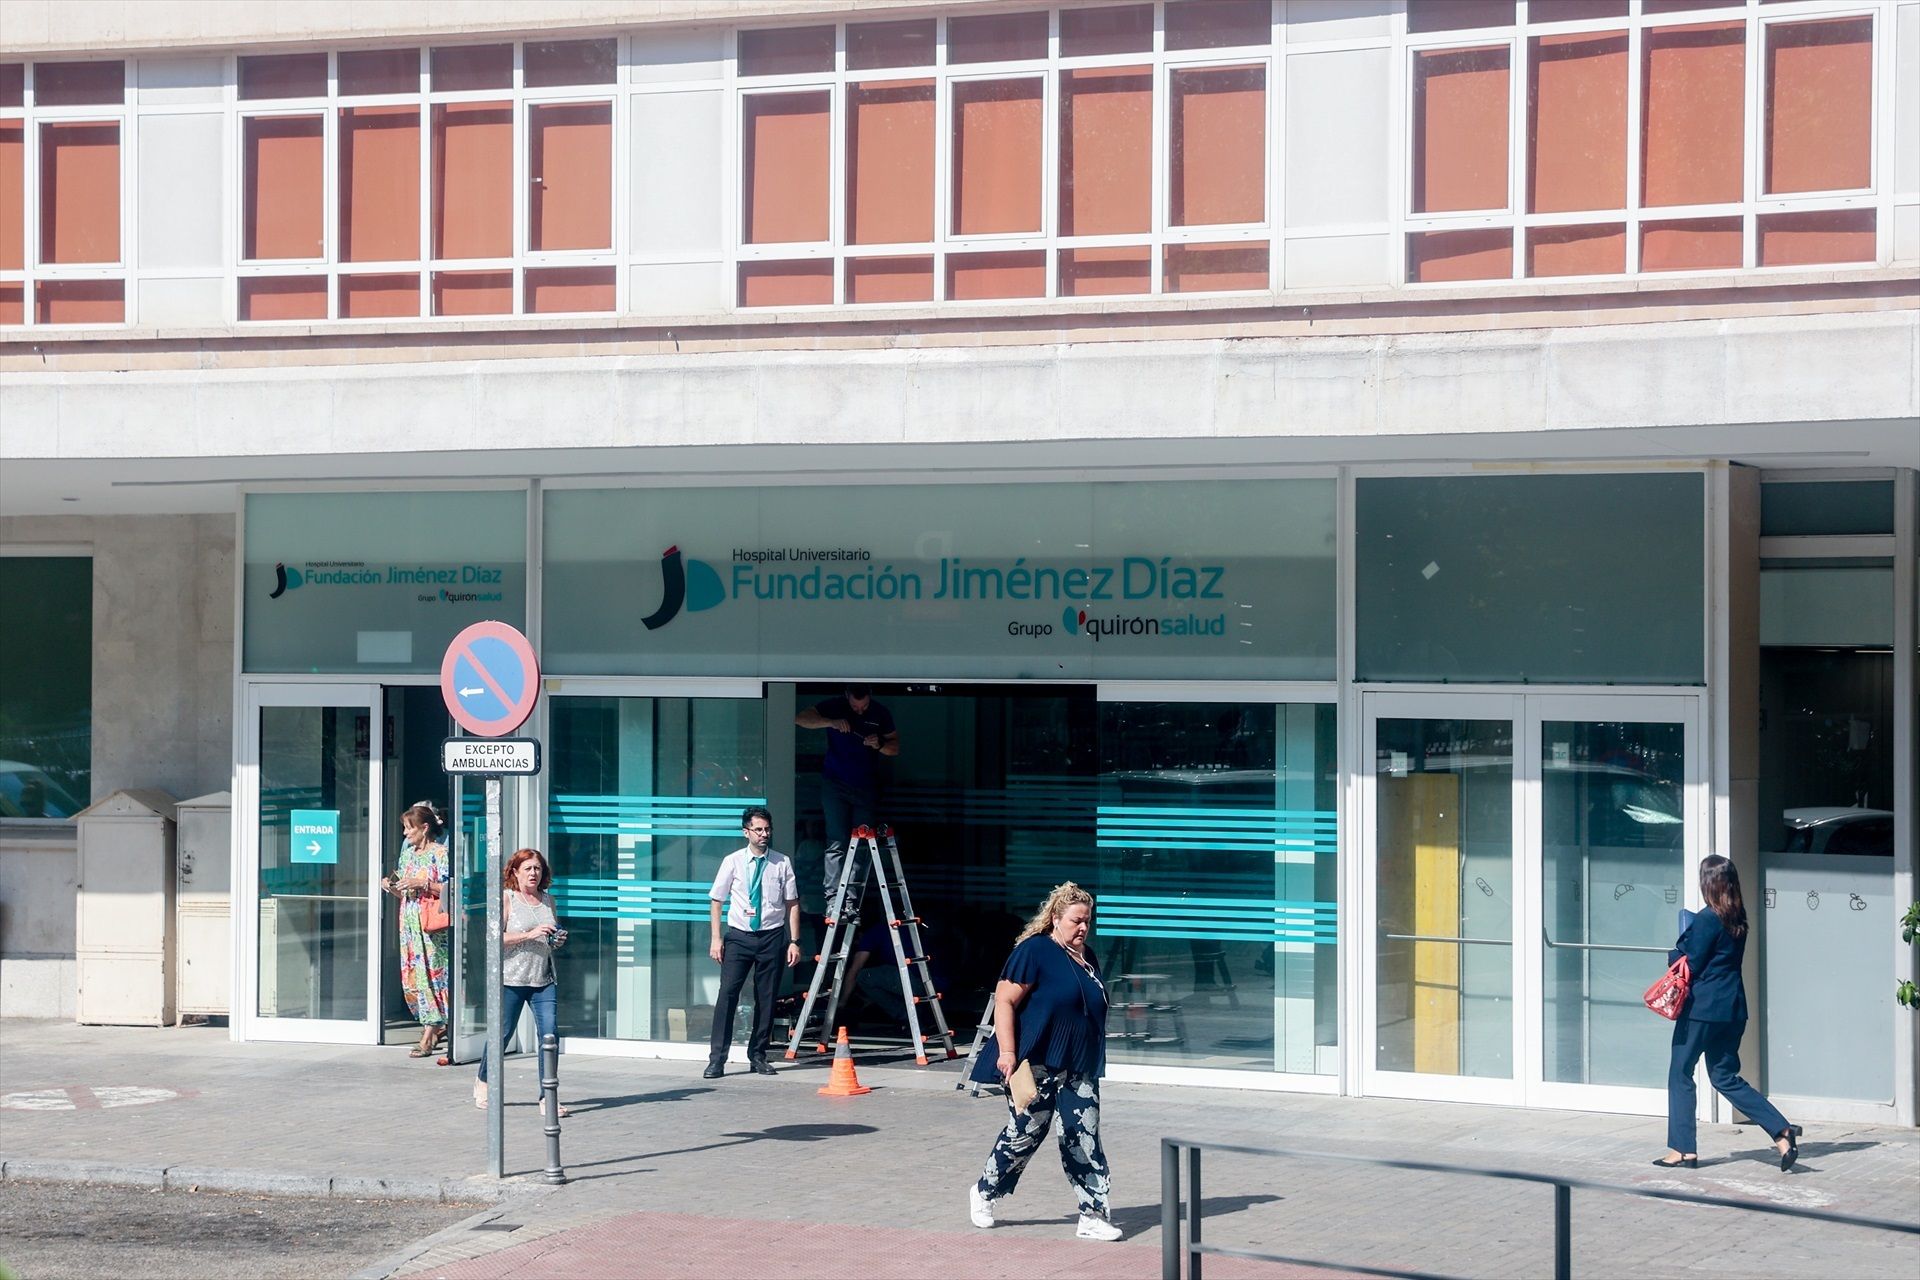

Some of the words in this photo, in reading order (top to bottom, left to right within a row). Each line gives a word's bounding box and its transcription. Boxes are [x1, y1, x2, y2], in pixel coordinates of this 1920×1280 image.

[732, 548, 786, 564] Hospital
[789, 548, 871, 561] Universitario
[305, 569, 381, 584] Fundación
[386, 566, 457, 584] Jiménez
[462, 565, 502, 583] Díaz
[732, 565, 922, 600] Fundación
[933, 557, 1114, 600] Jiménez
[1122, 556, 1225, 600] Díaz
[448, 592, 502, 604] quirónsalud
[1007, 621, 1053, 639] Grupo
[1086, 613, 1225, 642] quirónsalud
[465, 744, 515, 755] EXCEPTO
[452, 758, 529, 769] AMBULANCIAS
[294, 825, 334, 834] ENTRADA
